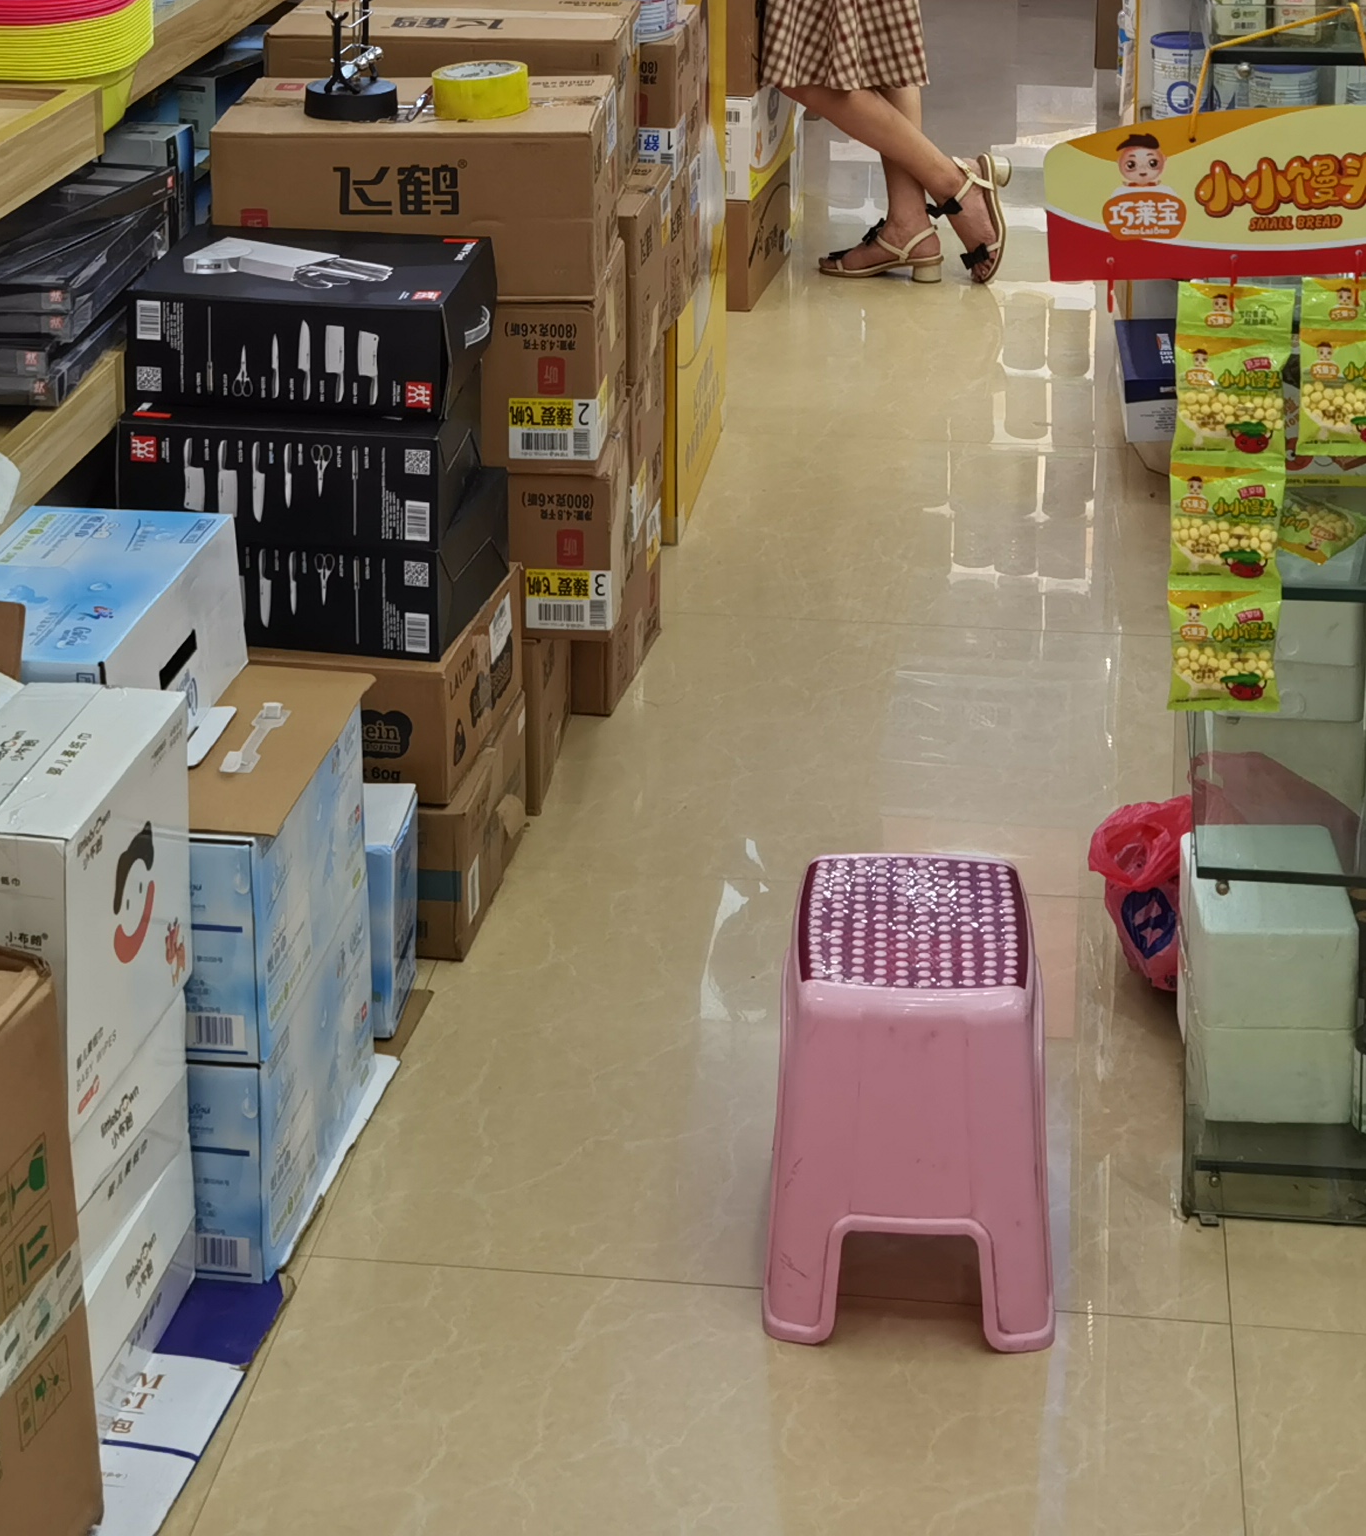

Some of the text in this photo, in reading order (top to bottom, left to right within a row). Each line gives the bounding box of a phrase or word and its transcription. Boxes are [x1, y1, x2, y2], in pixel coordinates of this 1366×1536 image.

[333, 163, 460, 216] 飞鹤
[1108, 199, 1183, 228] 巧莱宝
[1248, 214, 1342, 232] SMALL BREAD
[578, 403, 590, 426] 2
